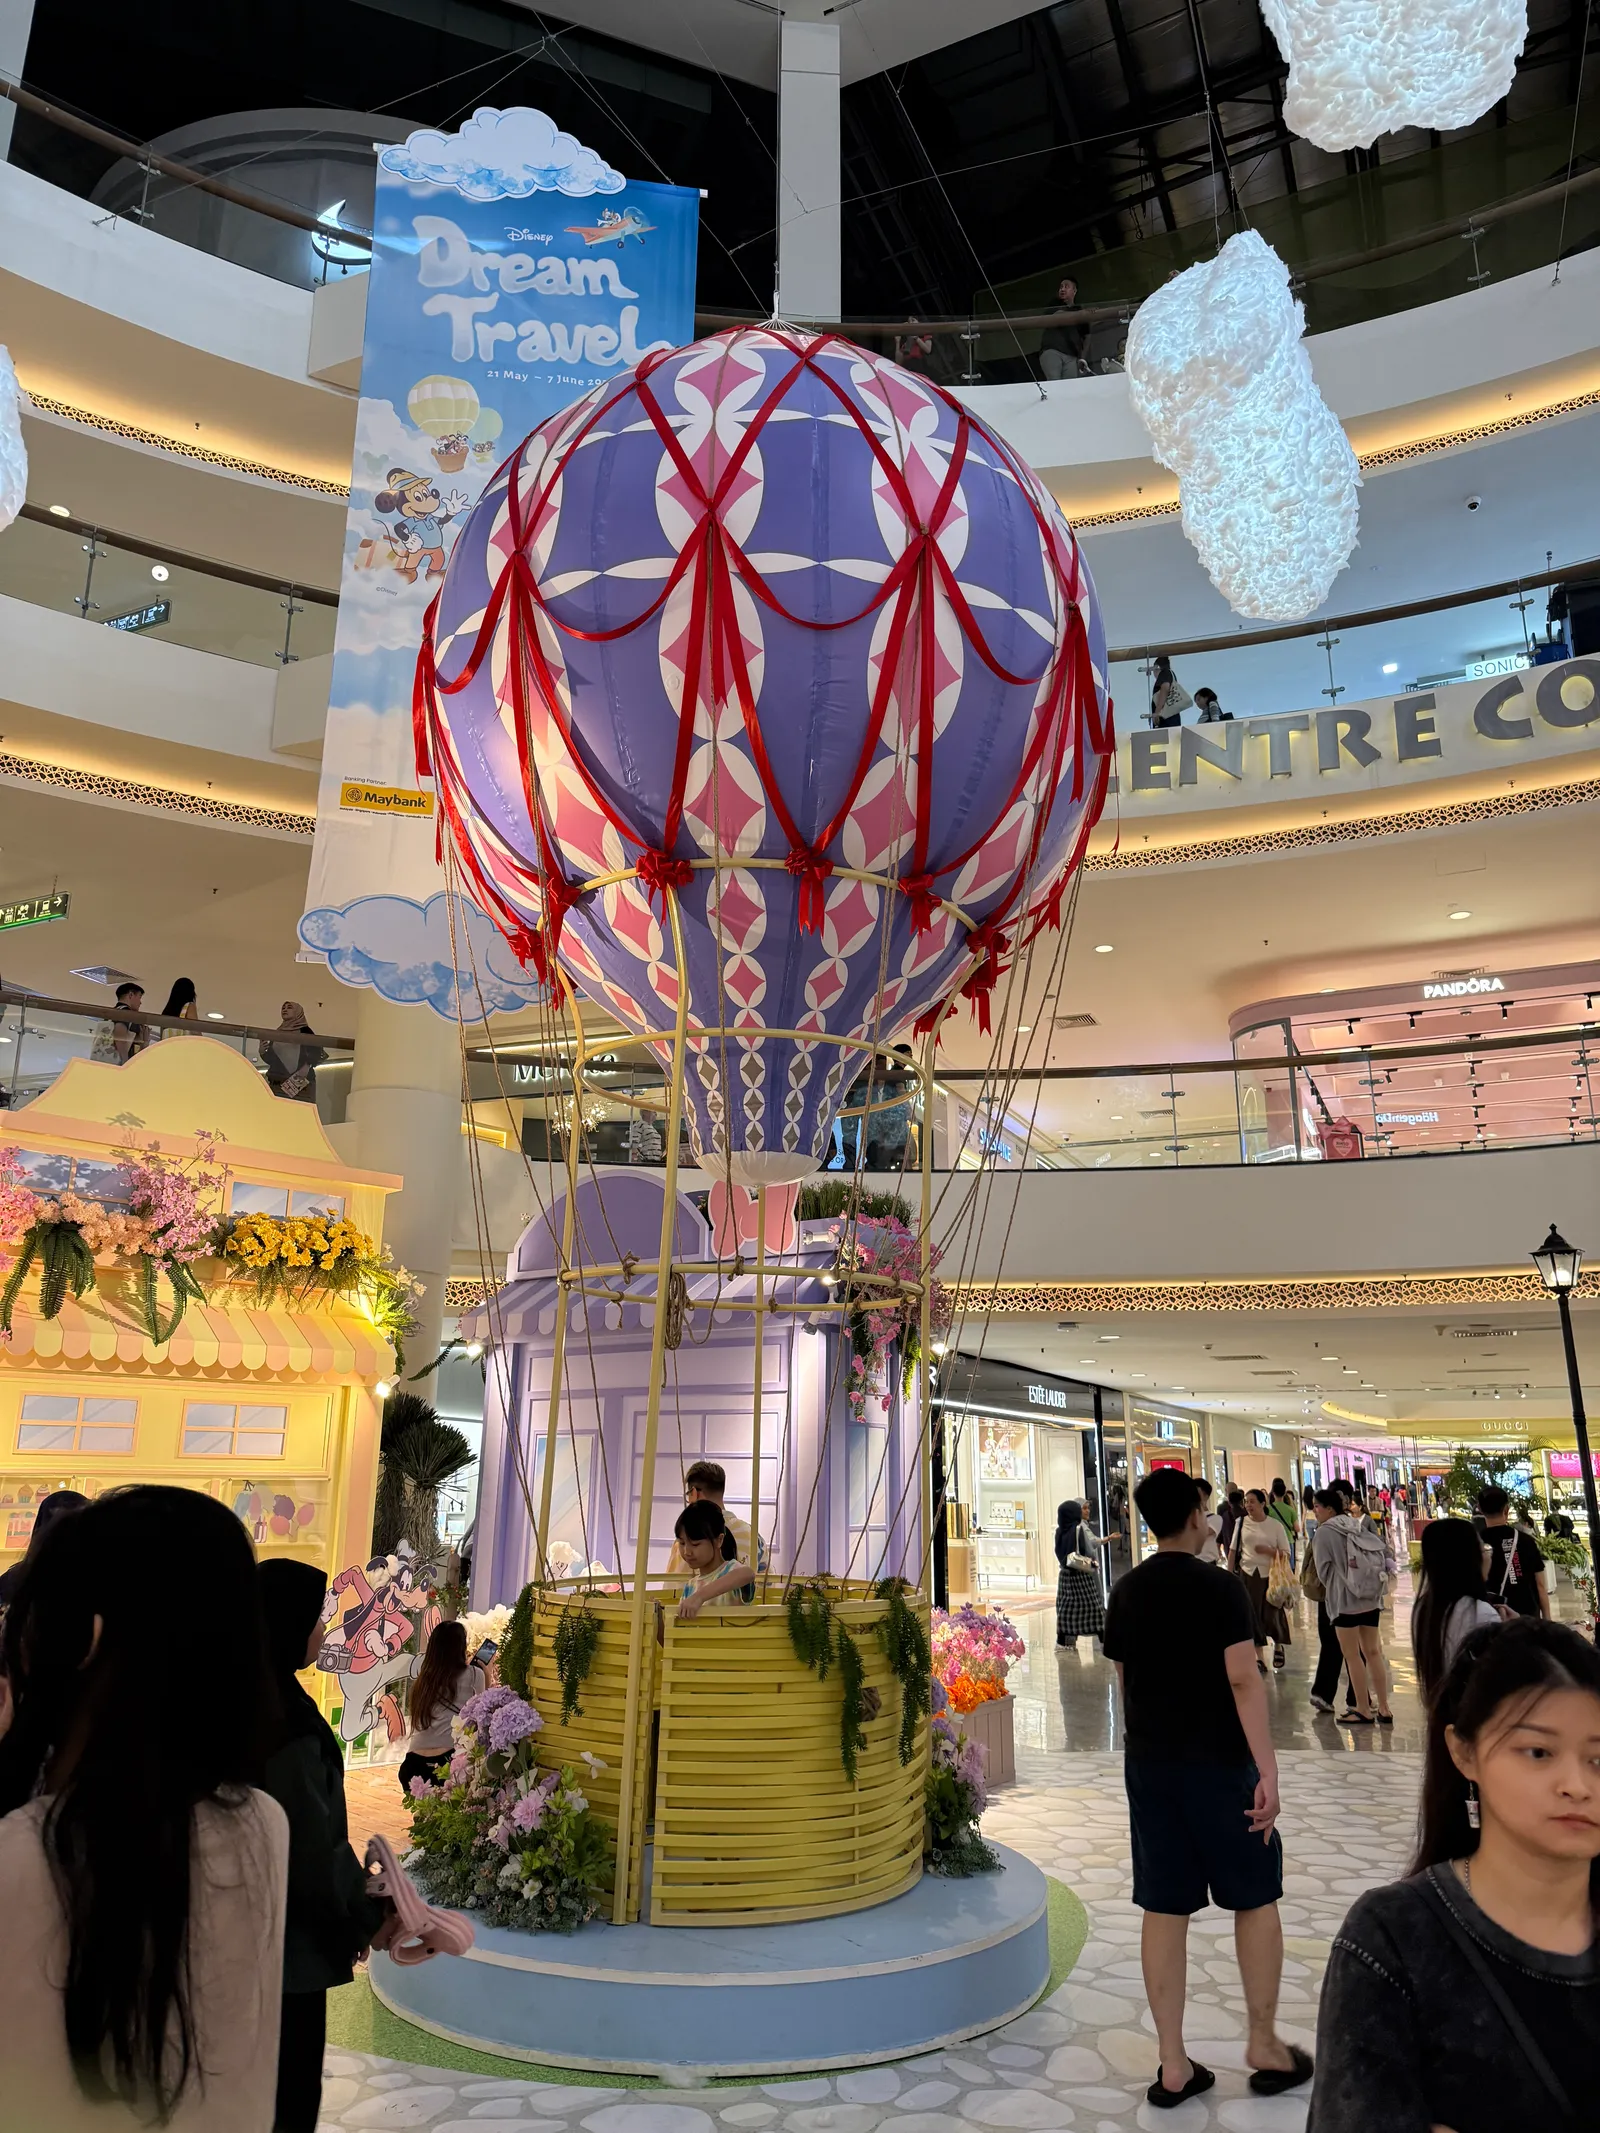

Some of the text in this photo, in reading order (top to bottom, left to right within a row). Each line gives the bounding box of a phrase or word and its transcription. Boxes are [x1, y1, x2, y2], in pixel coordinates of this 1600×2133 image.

[504, 226, 554, 246] Disney
[412, 215, 640, 299] Dream
[422, 292, 676, 367] Travel
[486, 370, 499, 378] 21
[503, 370, 529, 382] May
[547, 375, 553, 384] 7
[556, 374, 584, 386] June
[1473, 657, 1526, 677] SONIC
[1108, 692, 1444, 793] ENTRE
[364, 792, 426, 808] Maybank
[1423, 977, 1505, 999] PANDORA
[1045, 1388, 1067, 1409] LAUDER
[1481, 1421, 1529, 1431] GUCCI
